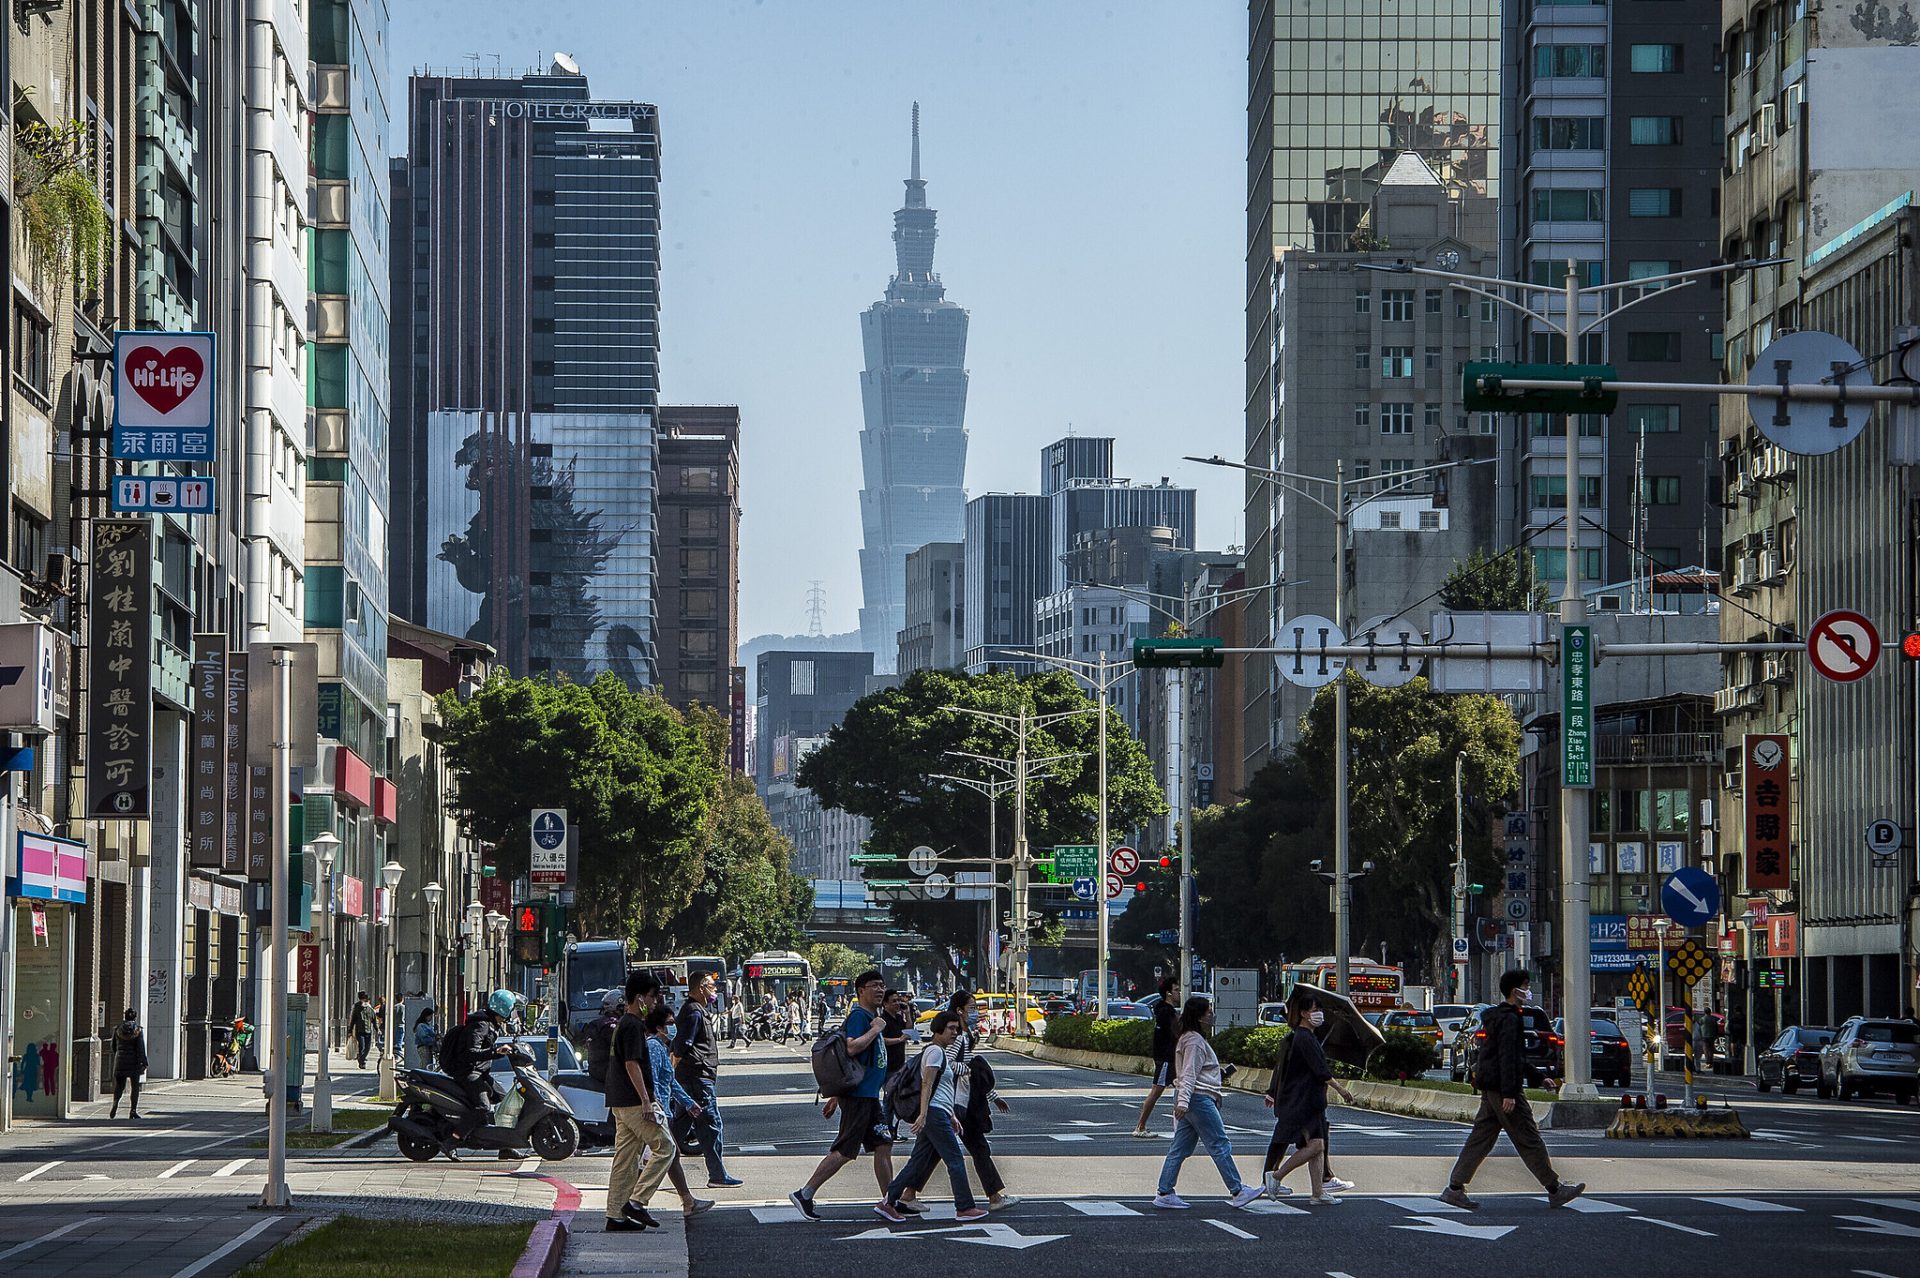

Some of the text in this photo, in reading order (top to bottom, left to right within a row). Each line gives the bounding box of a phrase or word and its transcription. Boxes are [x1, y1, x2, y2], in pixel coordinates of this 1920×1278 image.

[491, 102, 651, 120] HOTEL GRACERY
[134, 360, 196, 398] Hi-Life
[121, 431, 207, 454] 萊爾富
[102, 549, 139, 786] 劉桂蘭中醫診所
[1571, 651, 1584, 728] 忠孝東路一段
[228, 668, 246, 714] Milano
[196, 651, 222, 851] Milano 米蘭時尚診所
[1567, 729, 1587, 738] Zhong
[1755, 779, 1781, 876] 吉野家
[532, 853, 565, 862] 行人優先
[302, 948, 313, 993] 台中銀行
